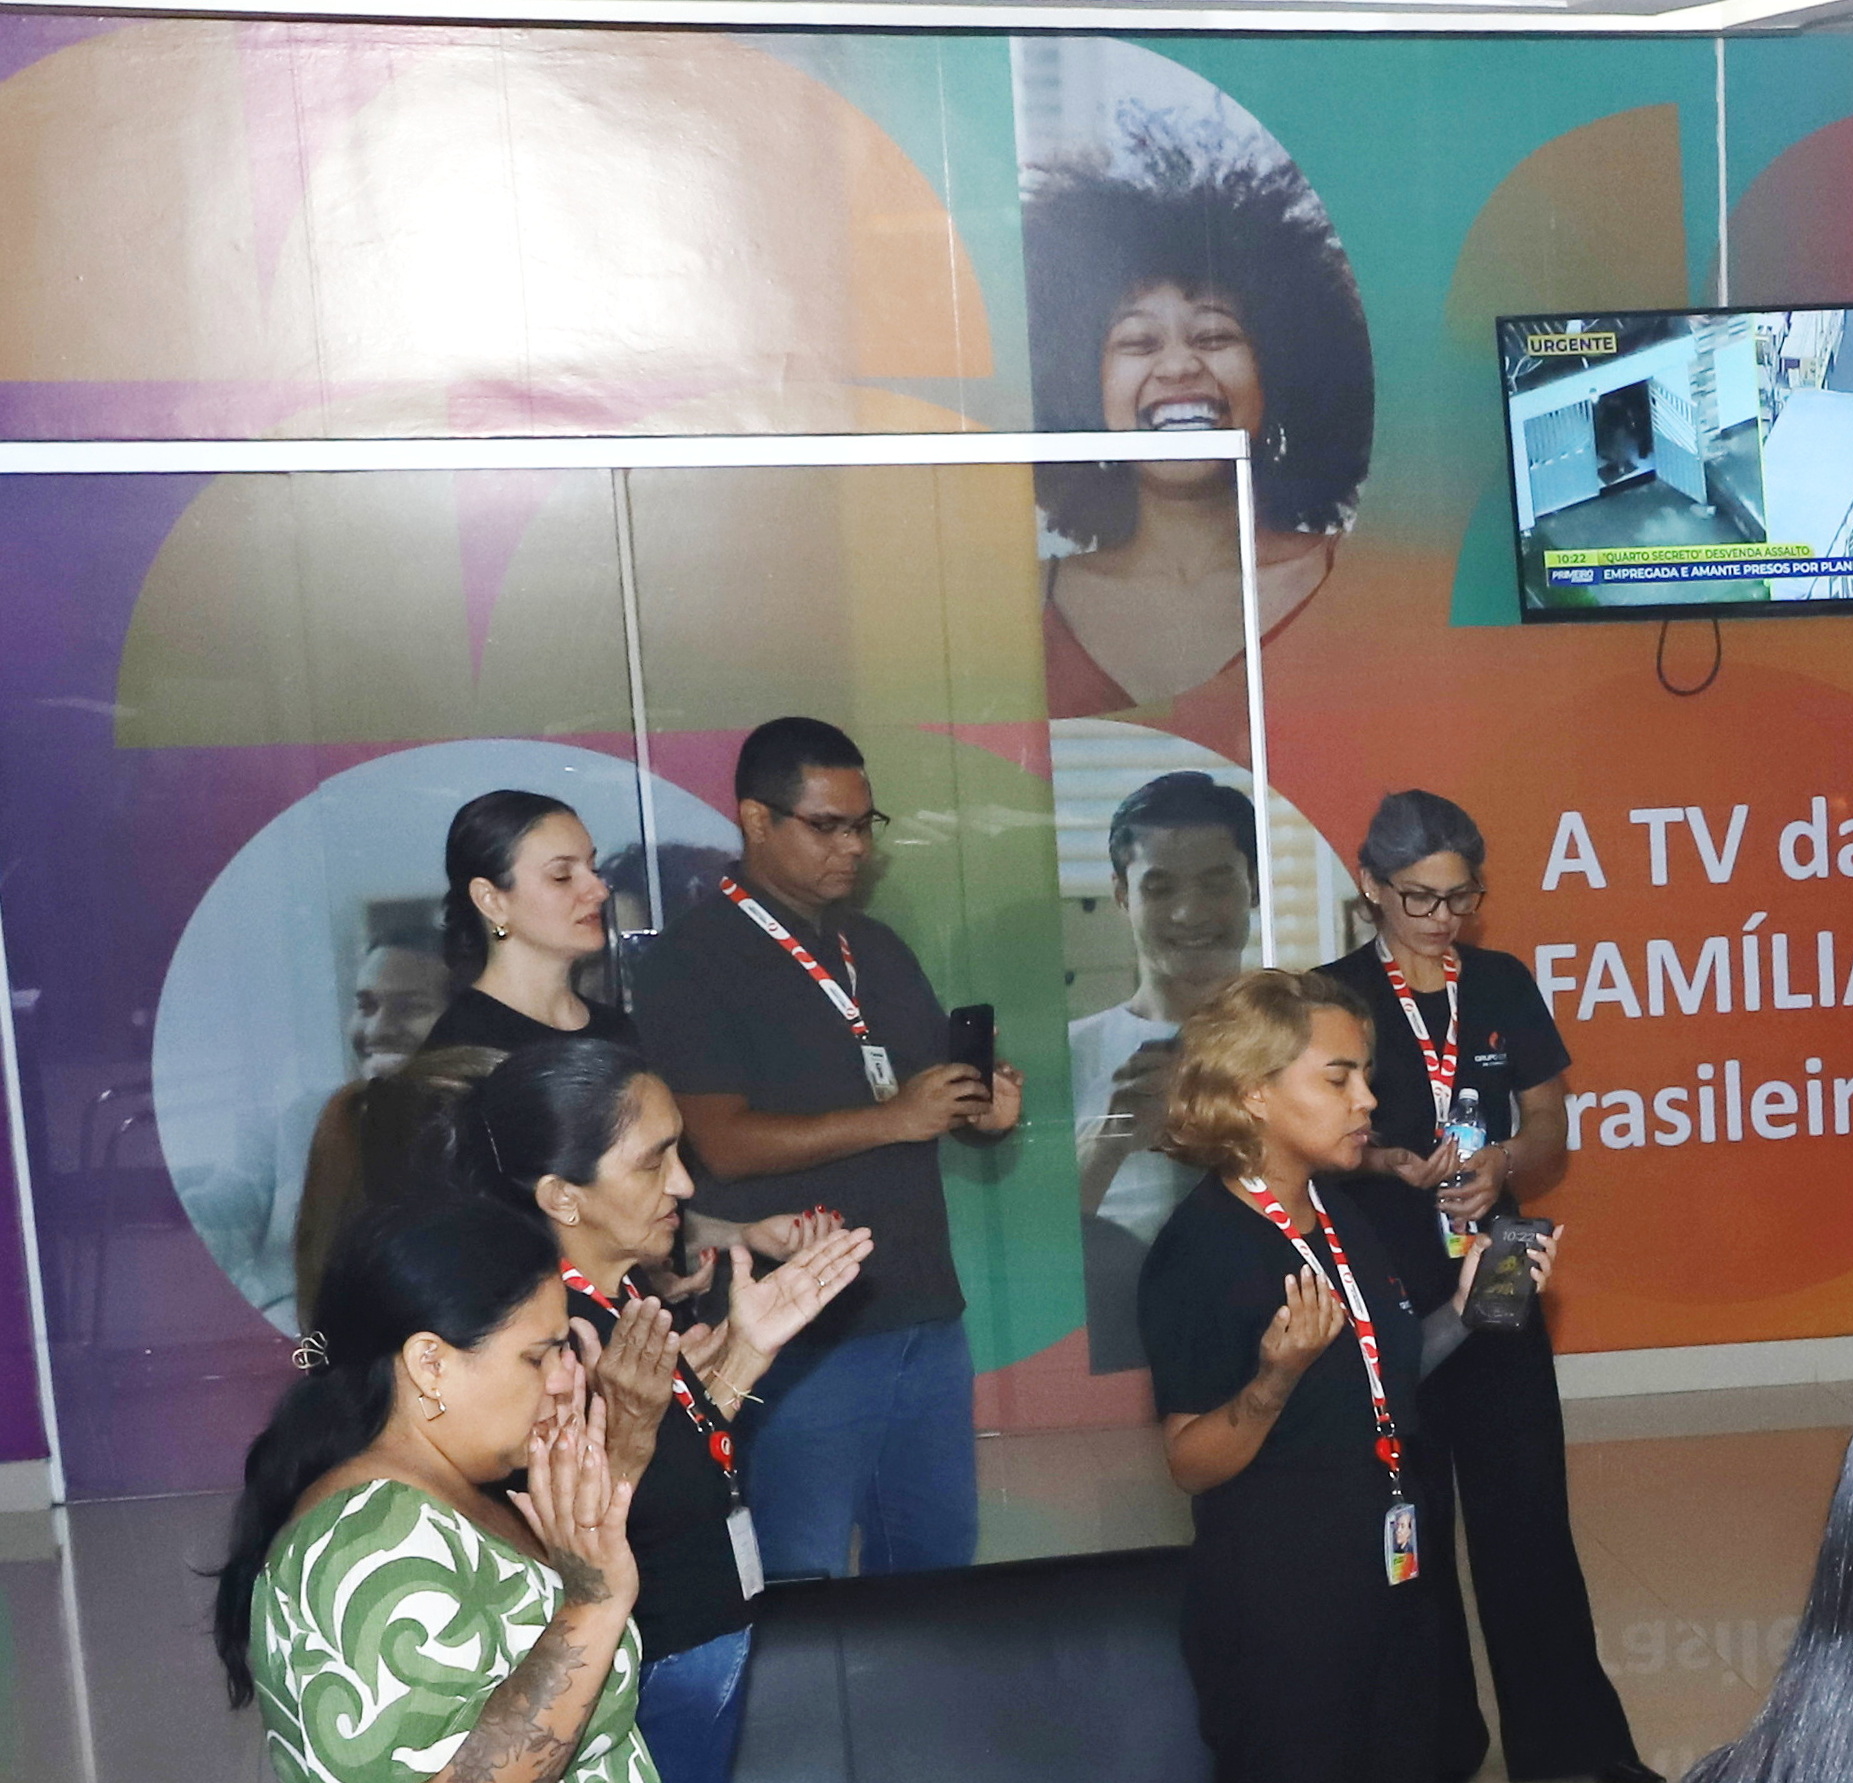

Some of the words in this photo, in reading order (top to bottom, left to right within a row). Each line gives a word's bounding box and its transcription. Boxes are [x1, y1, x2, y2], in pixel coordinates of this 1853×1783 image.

[1531, 336, 1614, 352] URGENTE
[1557, 554, 1587, 563] 10:22
[1705, 548, 1762, 559] DESVENDA
[1764, 546, 1810, 557] ASSALTO
[1603, 567, 1679, 580] EMPREGADA
[1681, 568, 1688, 577] E
[1691, 565, 1741, 577] AMANTE
[1743, 562, 1790, 575] PRESOS
[1793, 561, 1816, 573] POR
[1542, 811, 1607, 891] A
[1629, 804, 1749, 886] TV
[1503, 1231, 1535, 1242] 10:22
